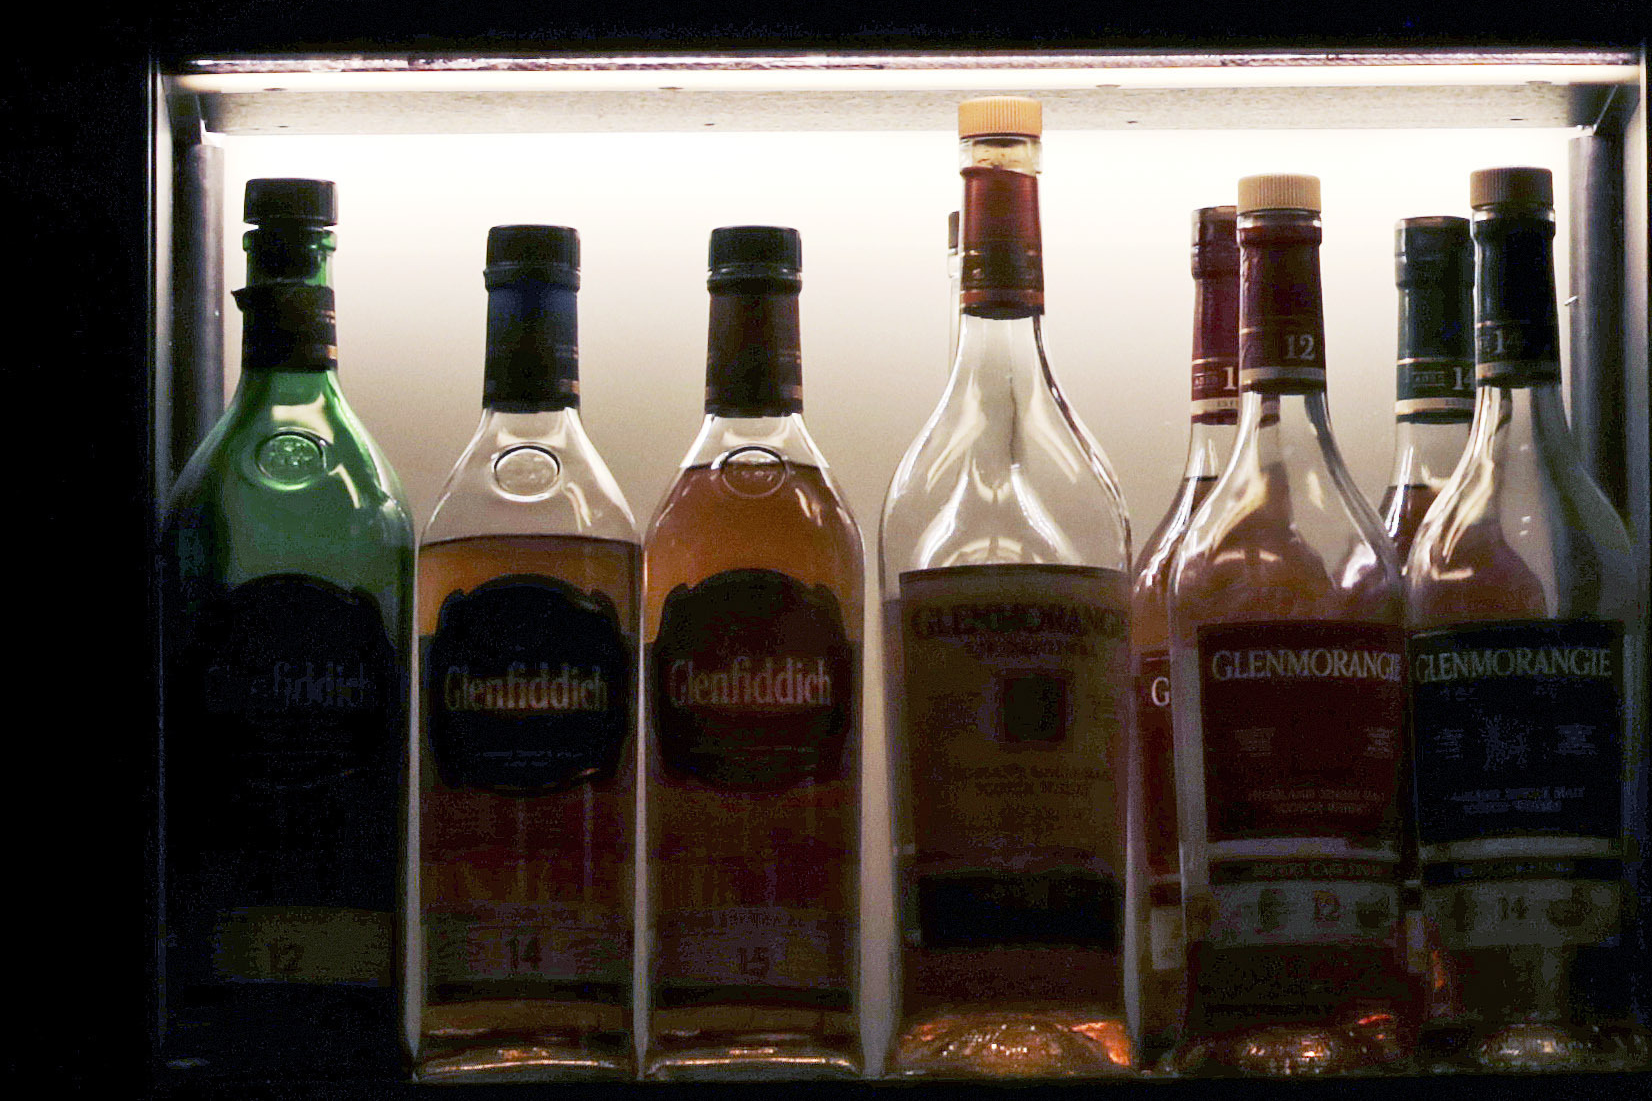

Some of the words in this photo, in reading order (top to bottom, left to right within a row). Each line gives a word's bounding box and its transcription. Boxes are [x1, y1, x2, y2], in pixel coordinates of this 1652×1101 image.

[1283, 334, 1318, 361] 12
[669, 655, 833, 706] Glenfiddich
[1415, 647, 1613, 682] GLENMORANGIE
[445, 661, 609, 711] Glenfiddich
[507, 934, 543, 971] 14
